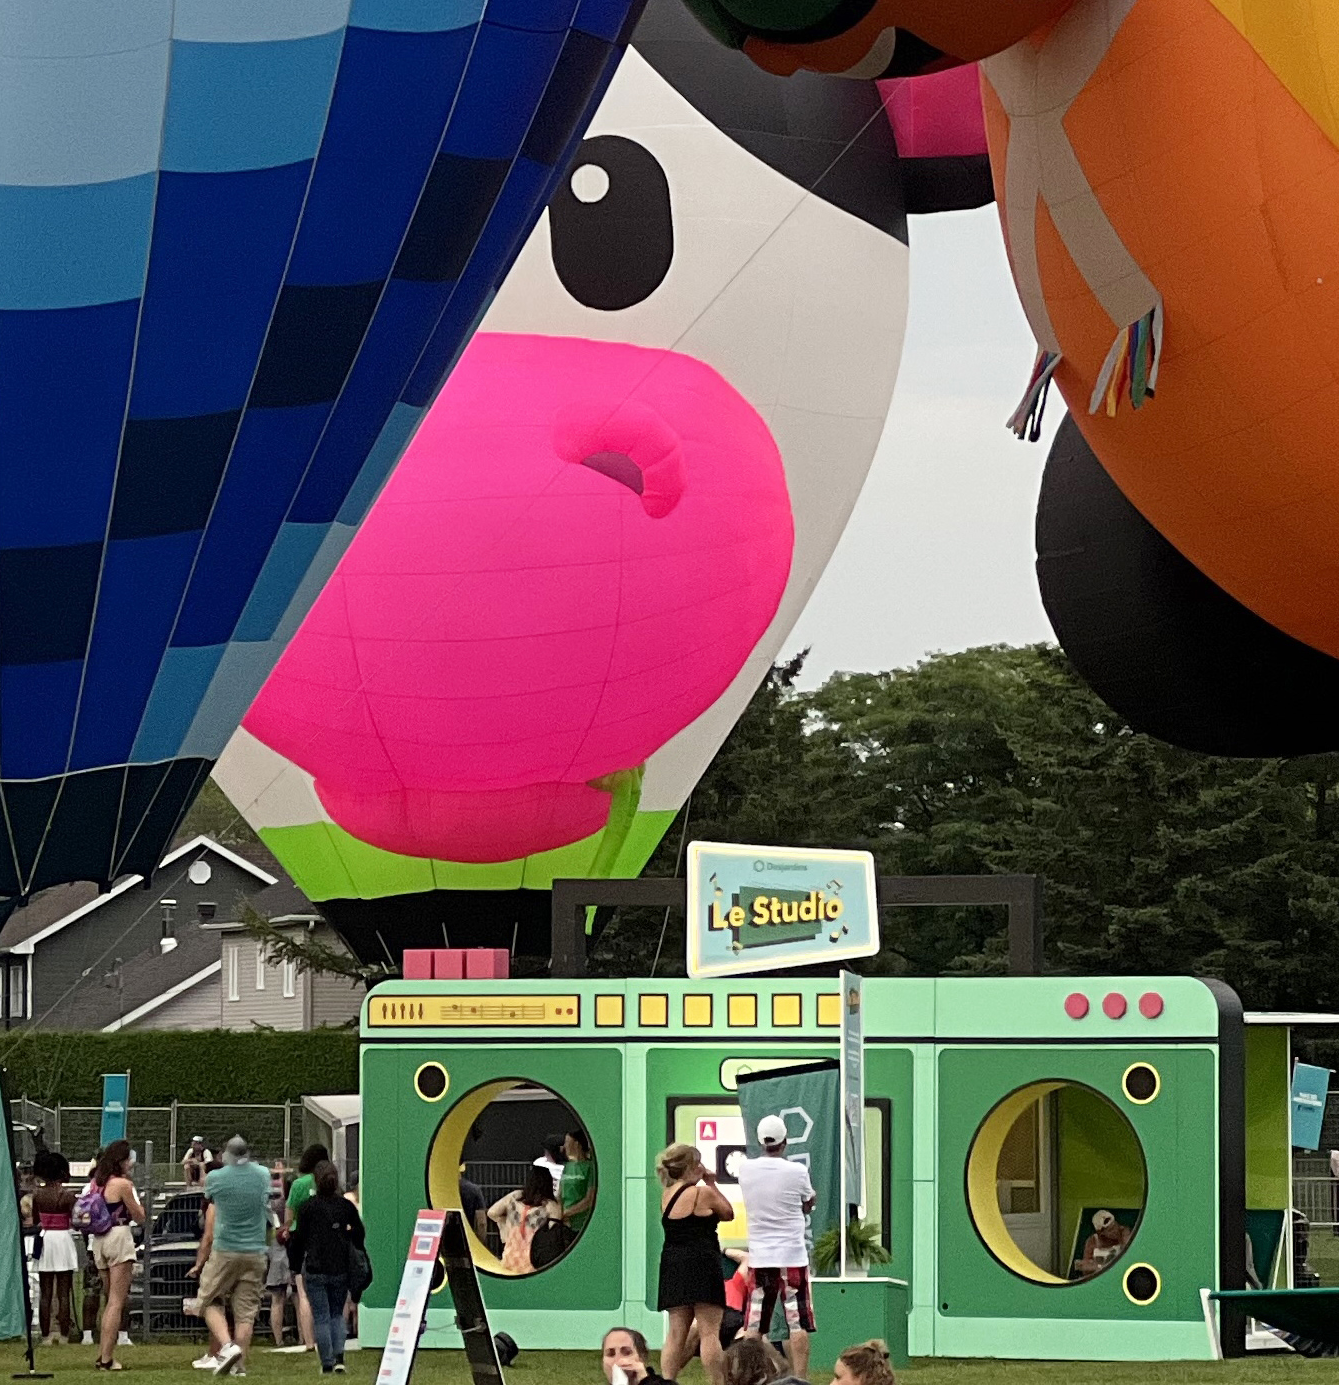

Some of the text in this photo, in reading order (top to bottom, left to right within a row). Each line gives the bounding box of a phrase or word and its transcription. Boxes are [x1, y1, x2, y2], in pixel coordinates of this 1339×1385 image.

[766, 862, 808, 873] Desjardins
[711, 890, 845, 929] Le Studio
